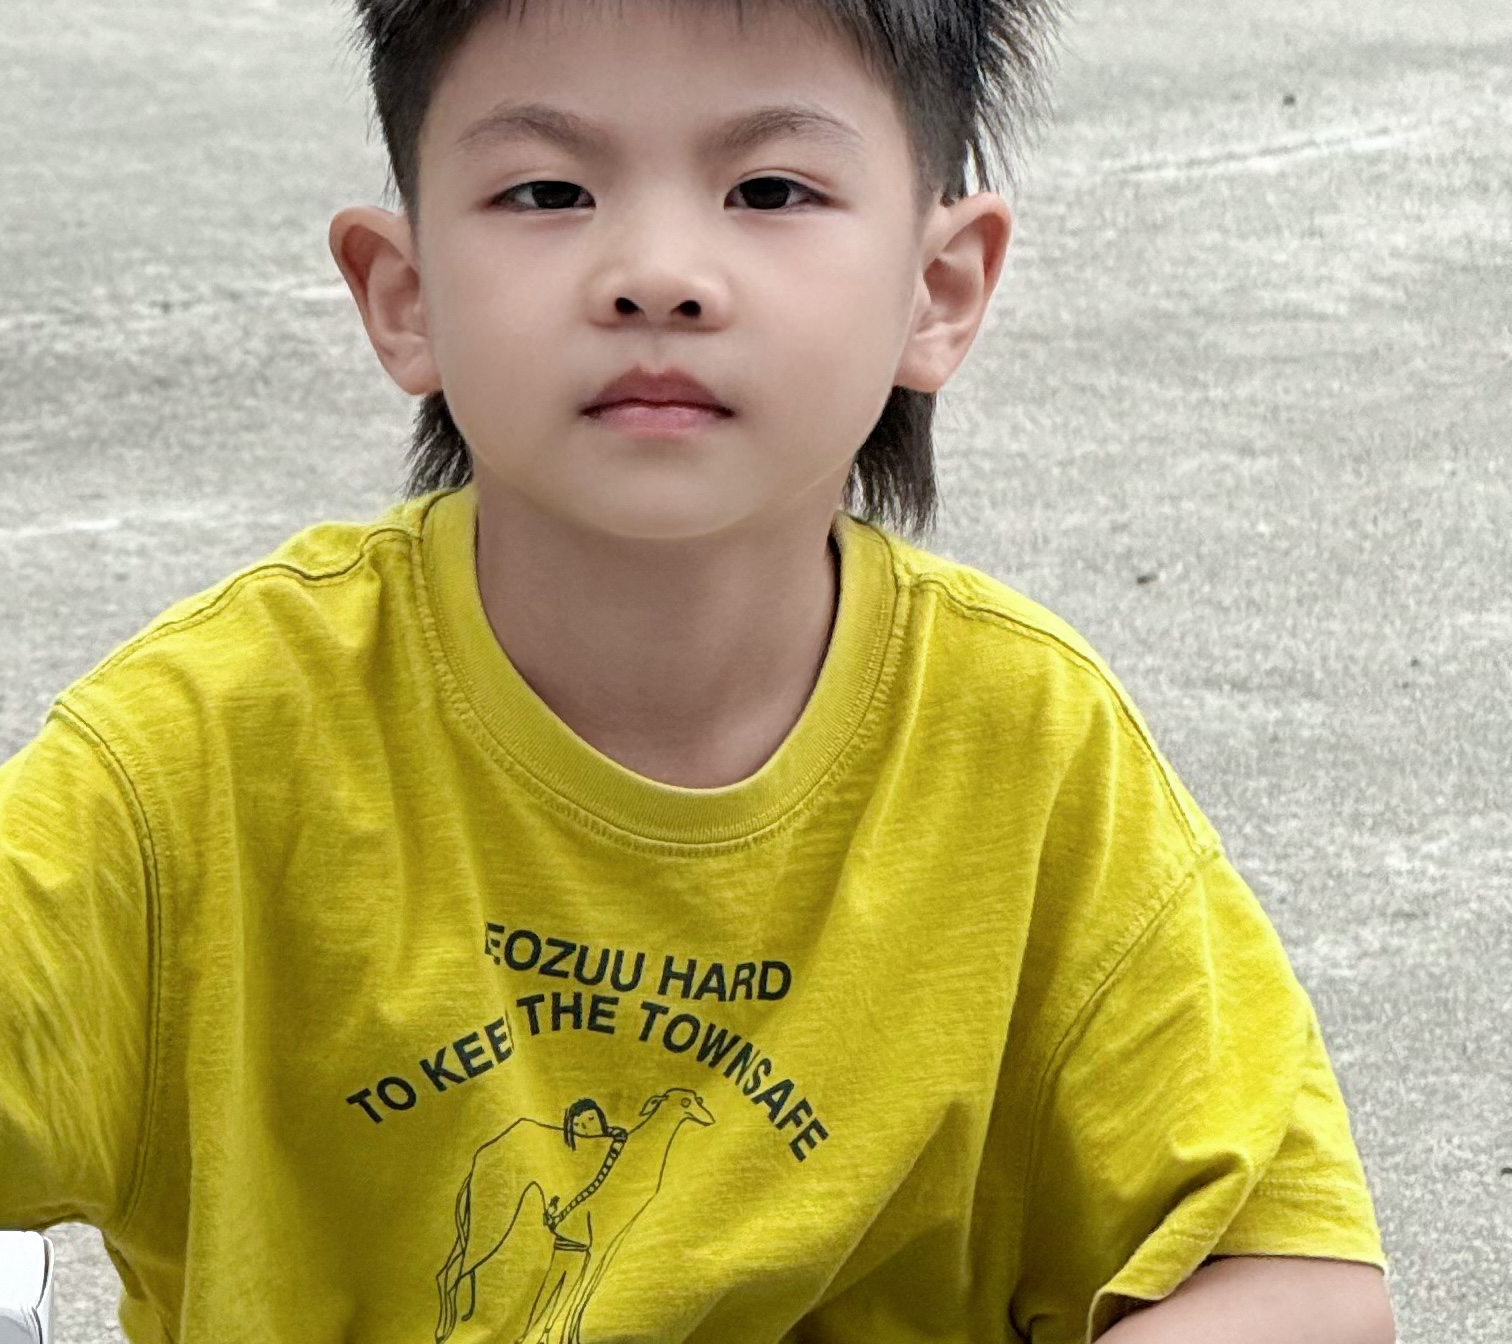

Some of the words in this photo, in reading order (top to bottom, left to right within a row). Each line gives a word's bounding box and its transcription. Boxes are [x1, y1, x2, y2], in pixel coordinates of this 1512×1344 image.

[658, 953, 793, 1002] HARD
[346, 1076, 417, 1124] TO
[516, 992, 619, 1036] THE
